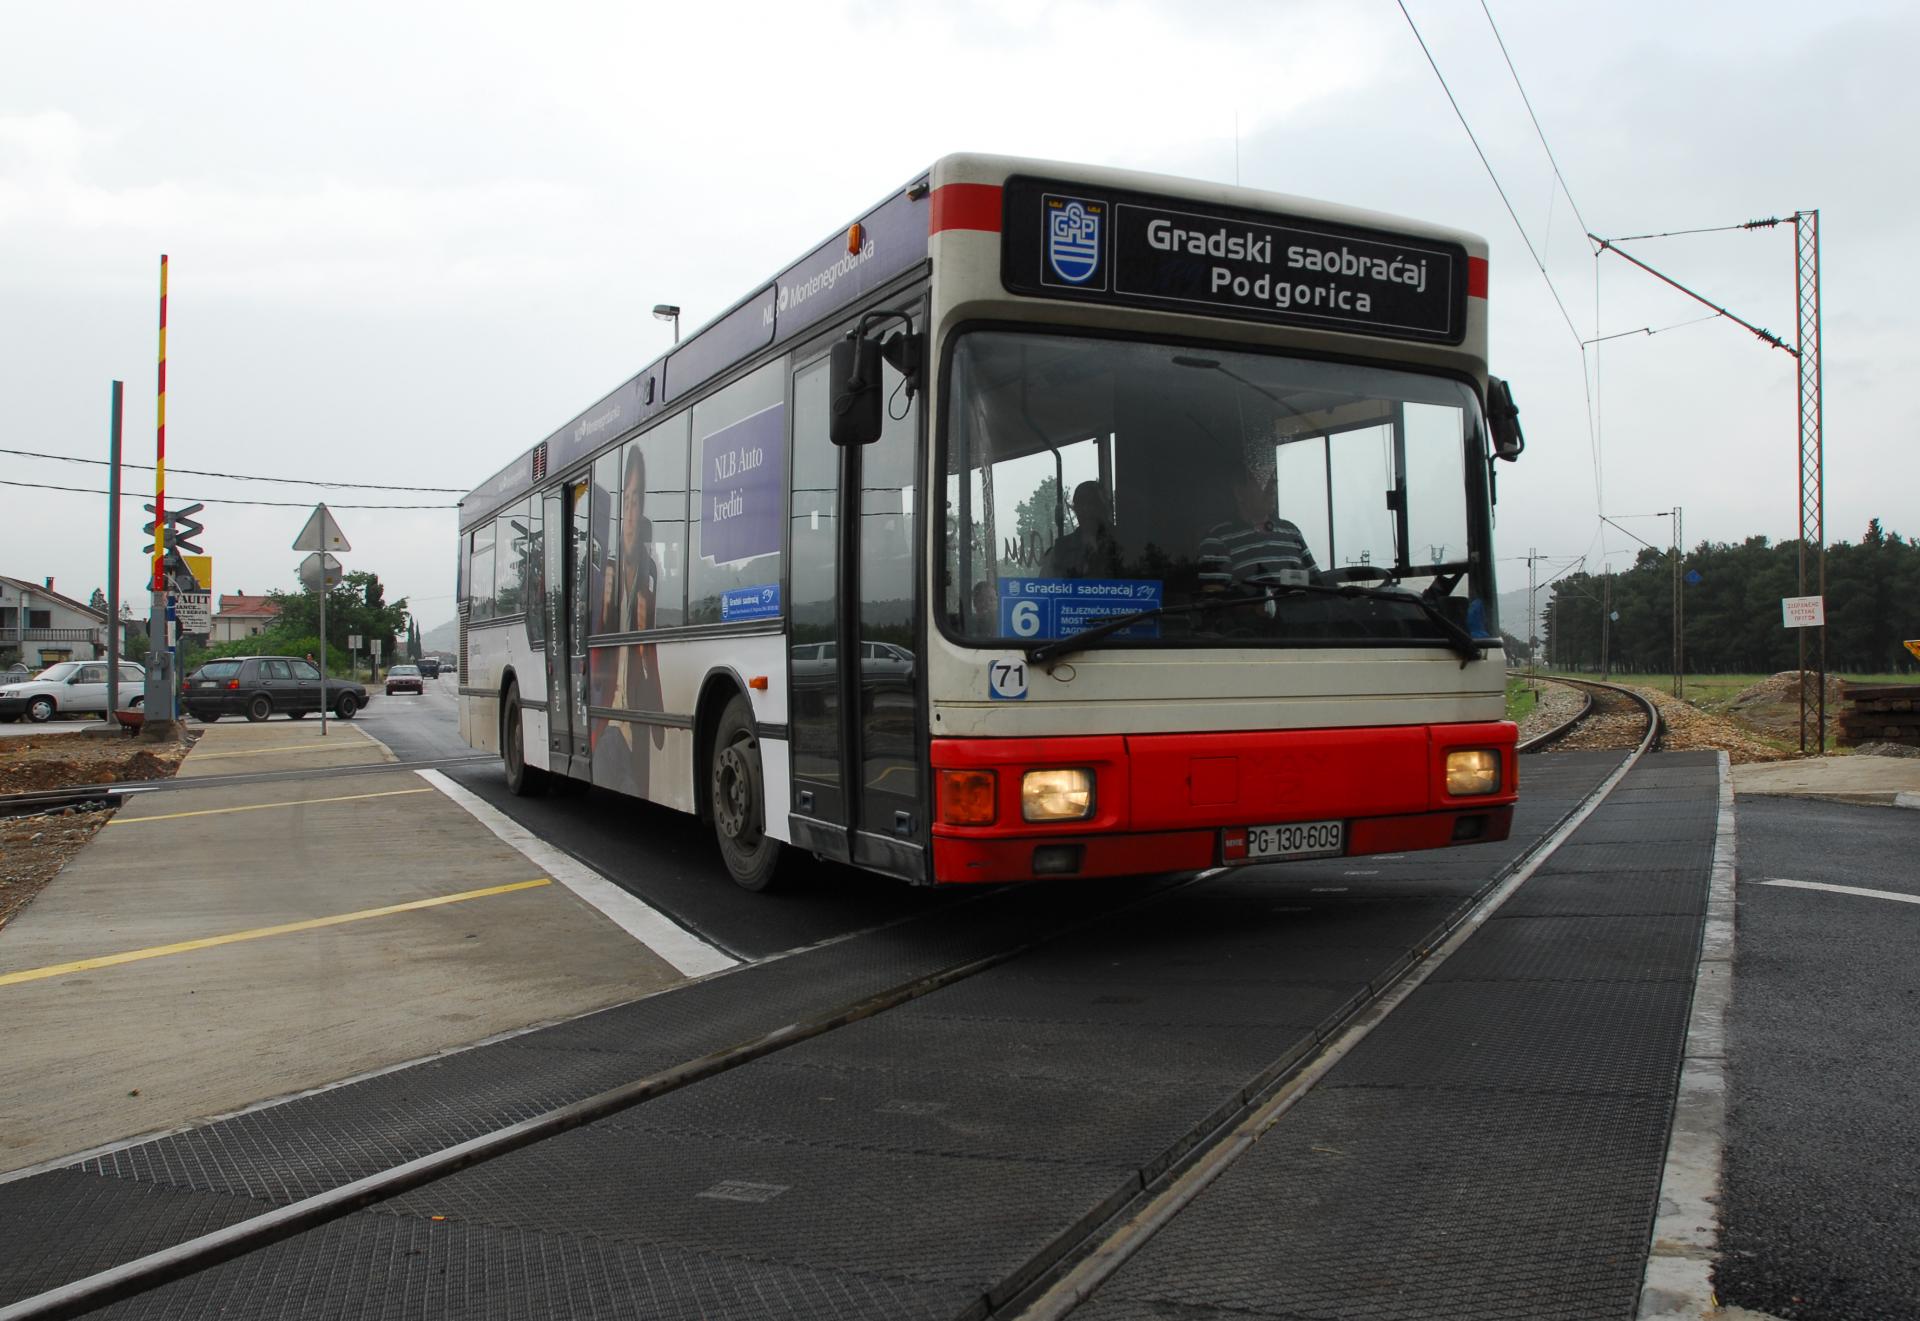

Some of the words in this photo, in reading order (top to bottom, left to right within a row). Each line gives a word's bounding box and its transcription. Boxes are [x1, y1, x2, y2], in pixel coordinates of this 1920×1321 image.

[790, 239, 874, 309] Montenegrobanka
[1147, 218, 1271, 264] Gradski
[1287, 244, 1427, 293] saobraćaj
[1211, 267, 1372, 313] Podgorica
[714, 450, 736, 483] NLB
[738, 446, 763, 474] Auto
[713, 487, 743, 522] krediti
[1025, 582, 1072, 594] Gradski
[1077, 584, 1133, 597] saobraćaj
[1011, 600, 1040, 637] 6
[1060, 616, 1084, 625] MOST
[995, 664, 1025, 688] 71
